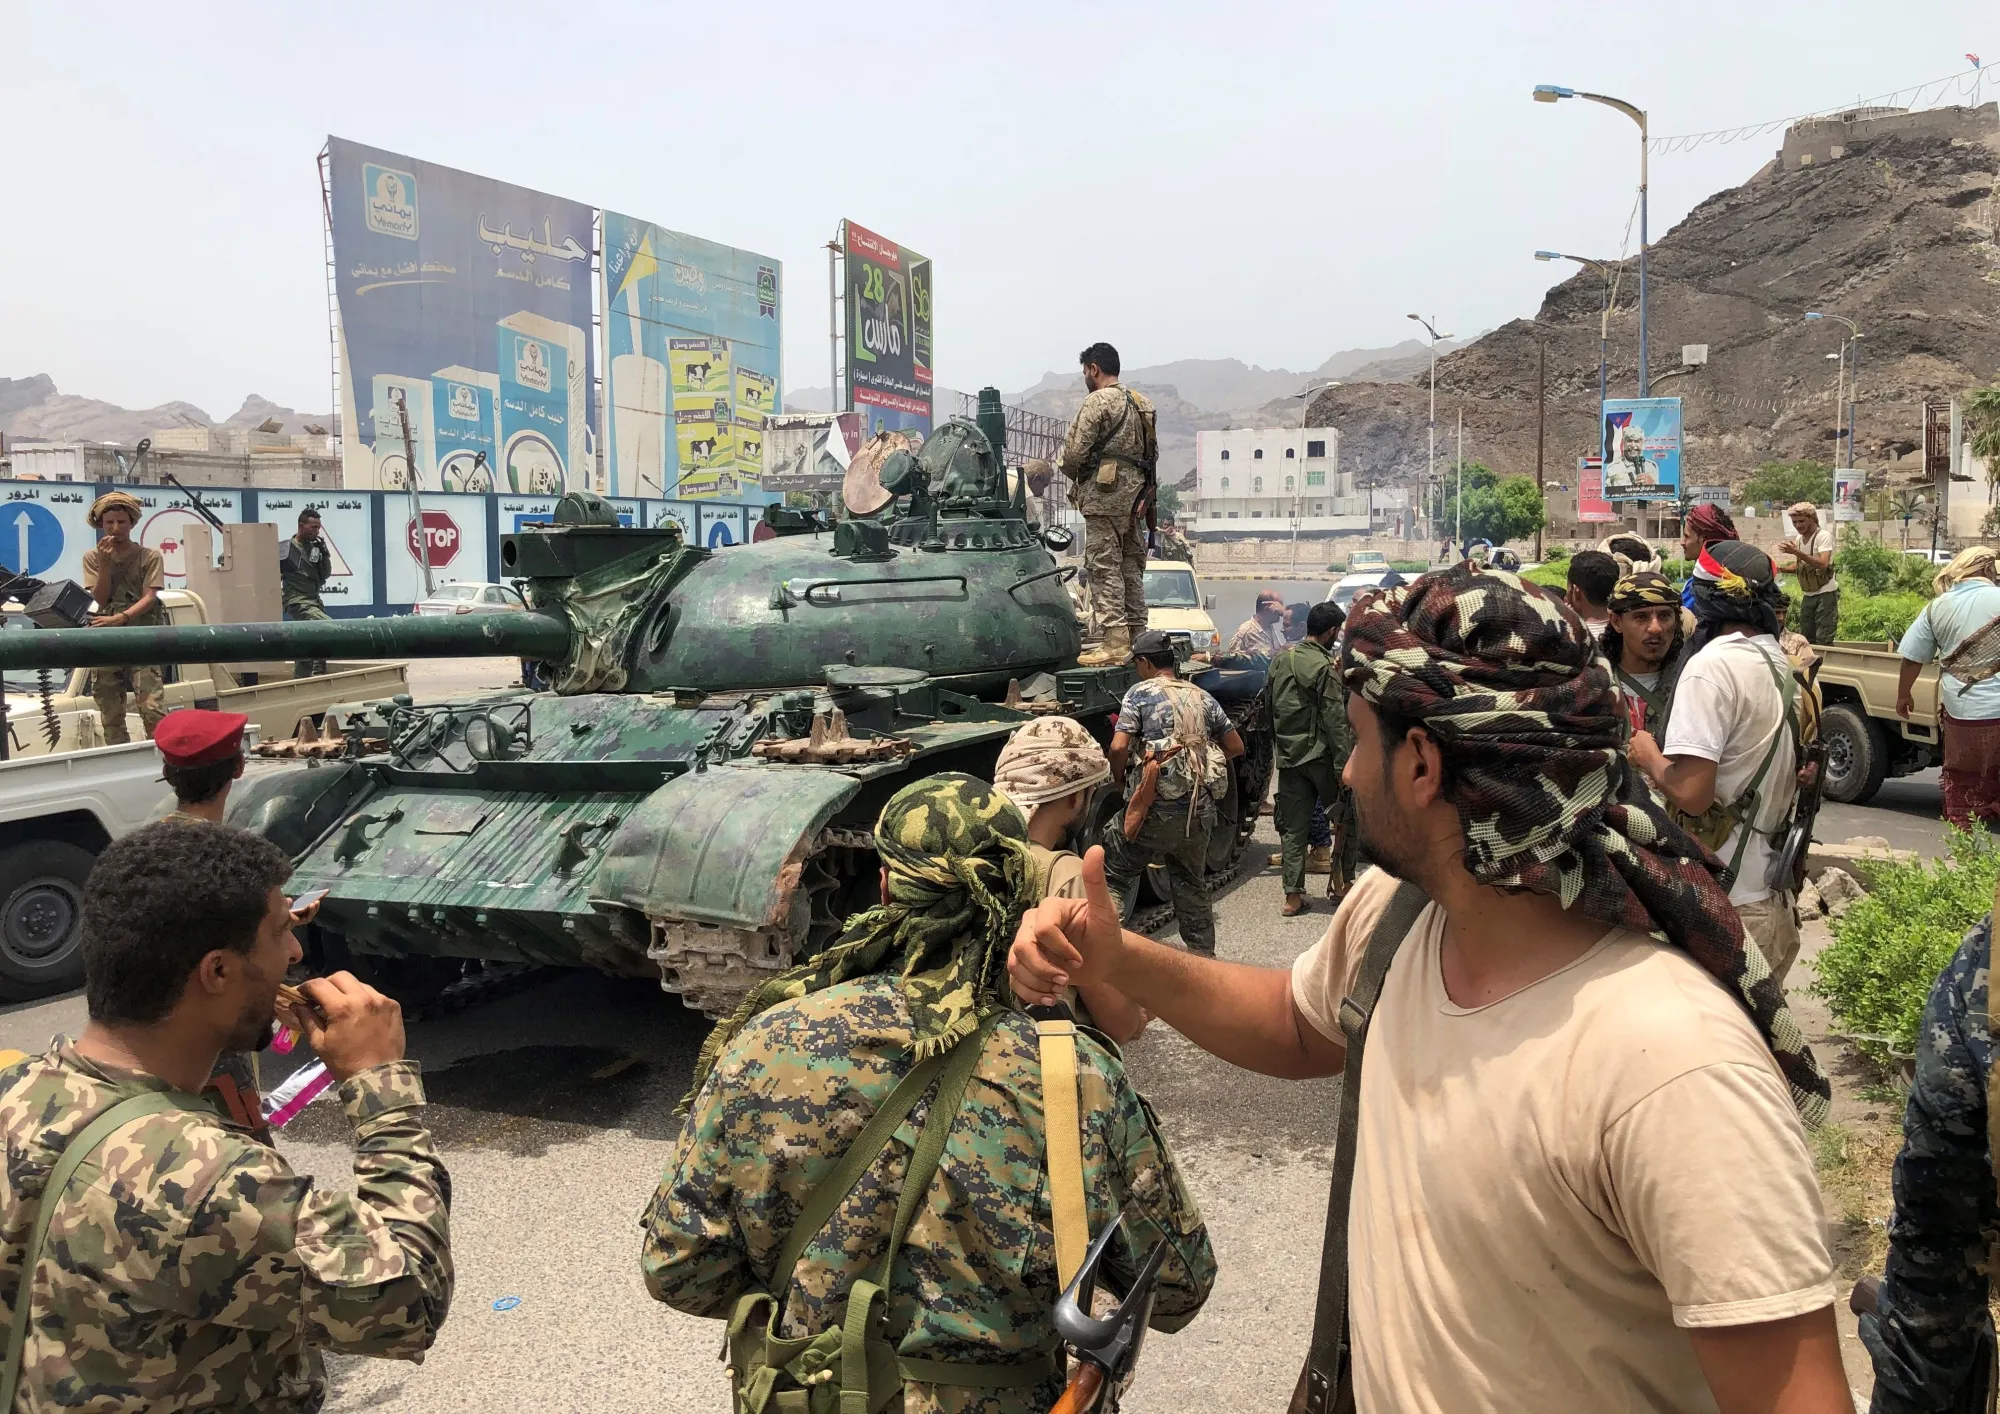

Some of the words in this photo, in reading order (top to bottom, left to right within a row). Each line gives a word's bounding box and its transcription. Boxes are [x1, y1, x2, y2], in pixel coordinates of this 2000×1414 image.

[373, 201, 412, 220] يماني
[478, 213, 589, 264] حليب
[494, 267, 534, 282] الدسم
[535, 273, 571, 290] كامل
[862, 263, 885, 303] 28
[864, 303, 901, 356] مارس
[504, 398, 527, 411] الدسم
[529, 405, 545, 418] كامل
[6, 489, 40, 500] المرور
[50, 492, 84, 504] علامات
[167, 498, 195, 509] لمرور
[203, 497, 233, 508] علامات
[305, 500, 329, 511] المرور
[336, 500, 362, 510] علامات
[529, 504, 550, 514] المرور
[411, 528, 457, 548] STOP
[319, 582, 349, 595] منعط
